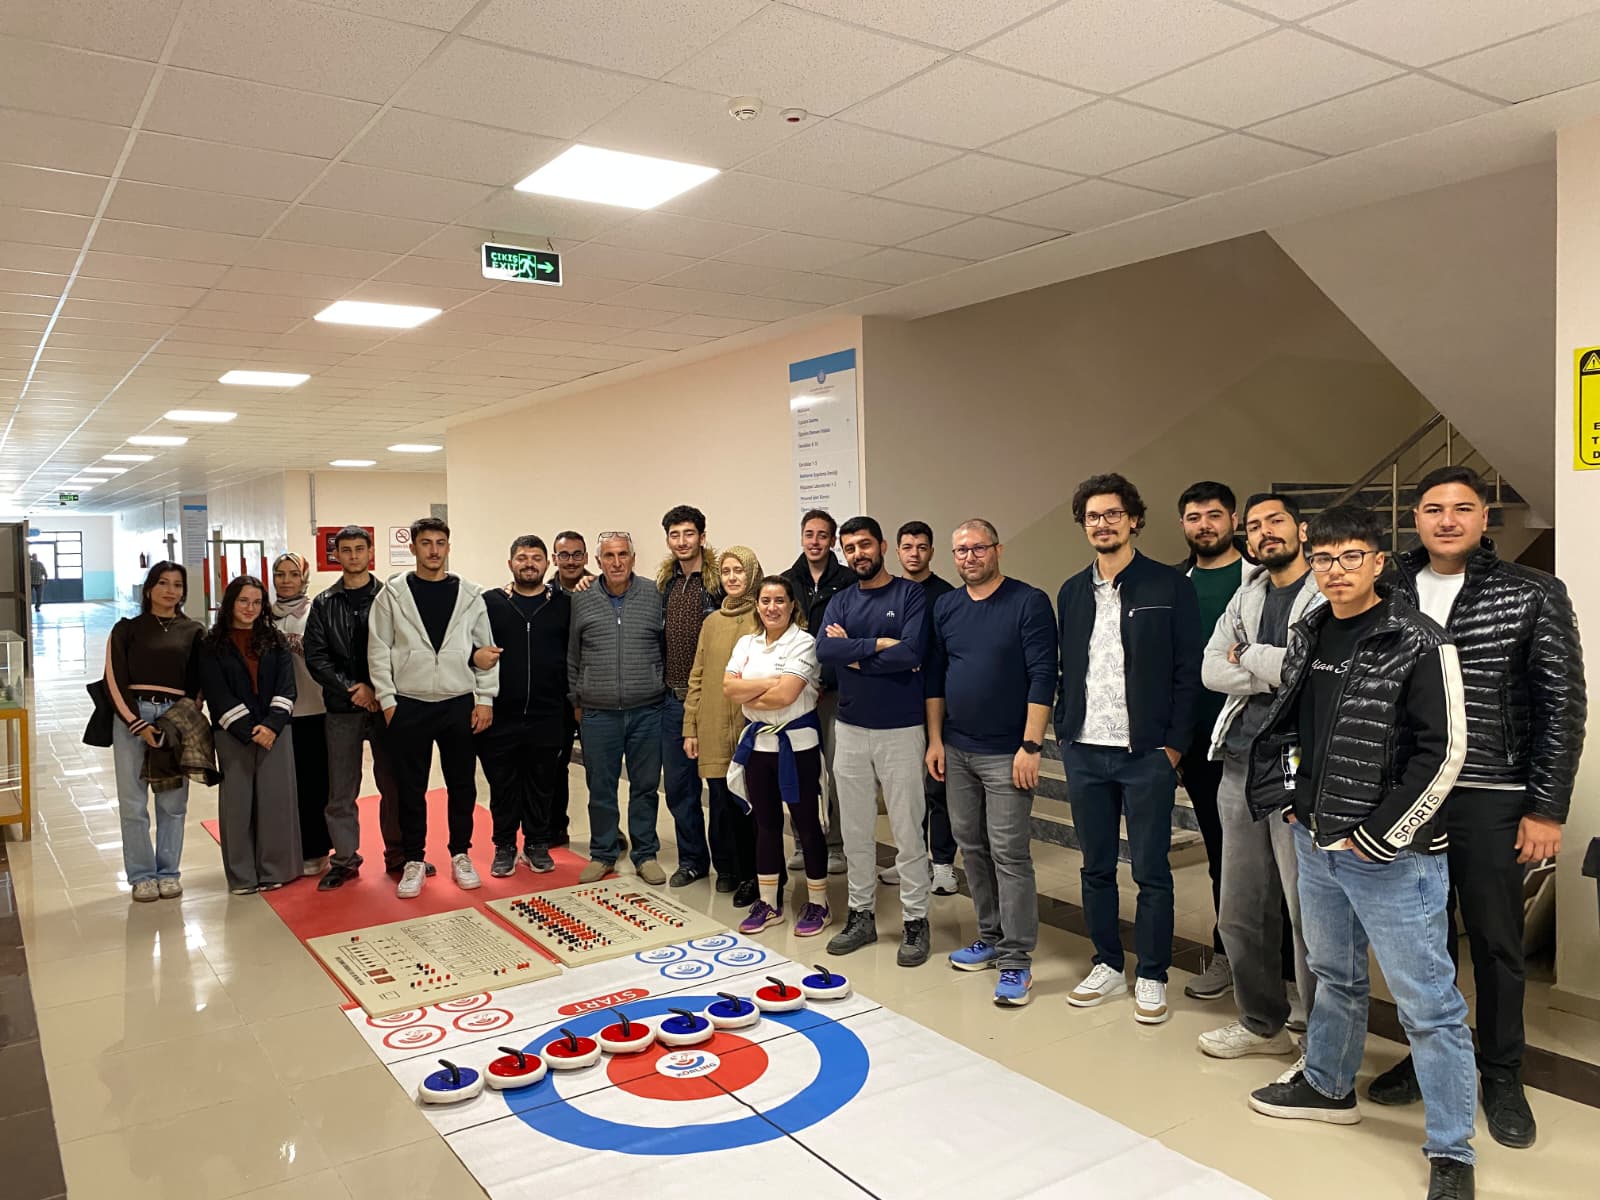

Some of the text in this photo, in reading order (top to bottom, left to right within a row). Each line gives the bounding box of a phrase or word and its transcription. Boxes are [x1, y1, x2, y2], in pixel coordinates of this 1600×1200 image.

[492, 261, 518, 271] EXIT
[1394, 794, 1439, 842] SPORTS
[574, 990, 637, 1013] START
